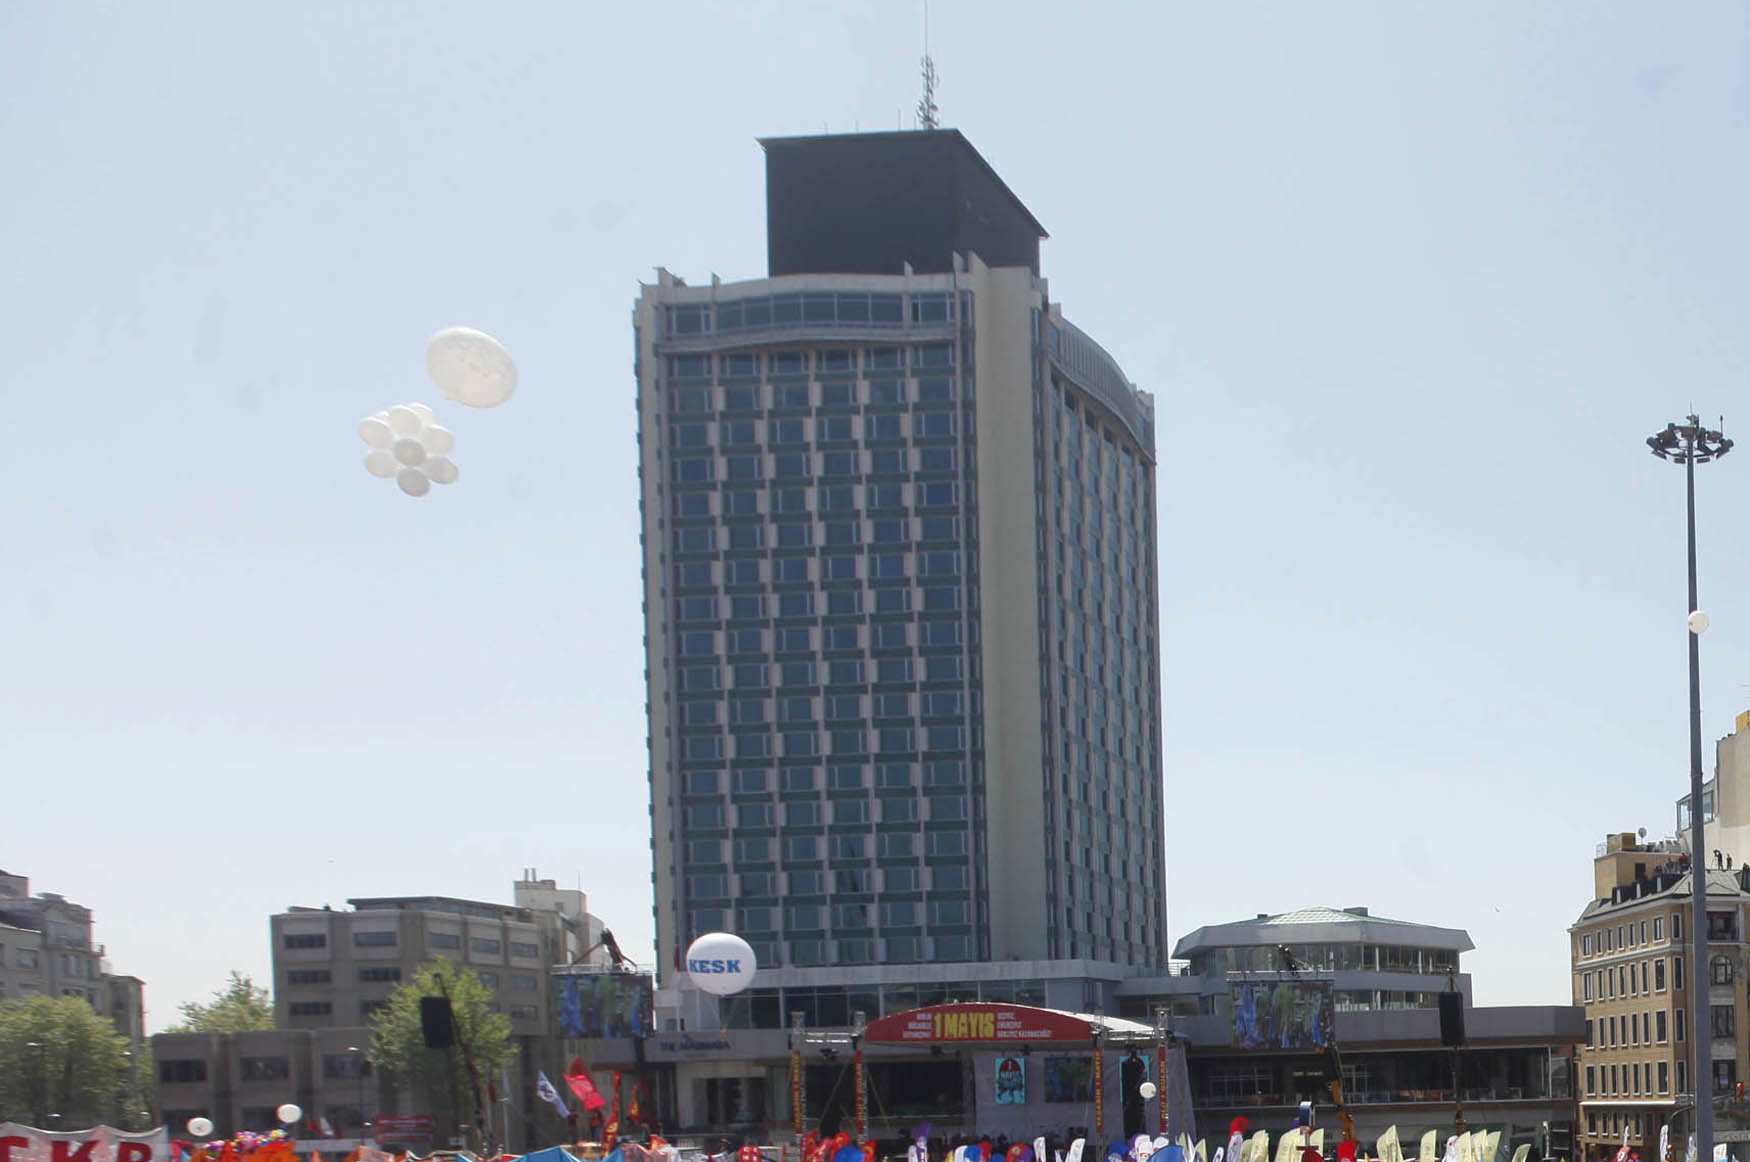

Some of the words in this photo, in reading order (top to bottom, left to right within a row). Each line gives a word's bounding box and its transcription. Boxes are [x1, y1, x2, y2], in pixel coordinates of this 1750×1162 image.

[688, 959, 741, 973] KESK
[934, 1014, 942, 1038] 1
[945, 1012, 995, 1038] MAYIS
